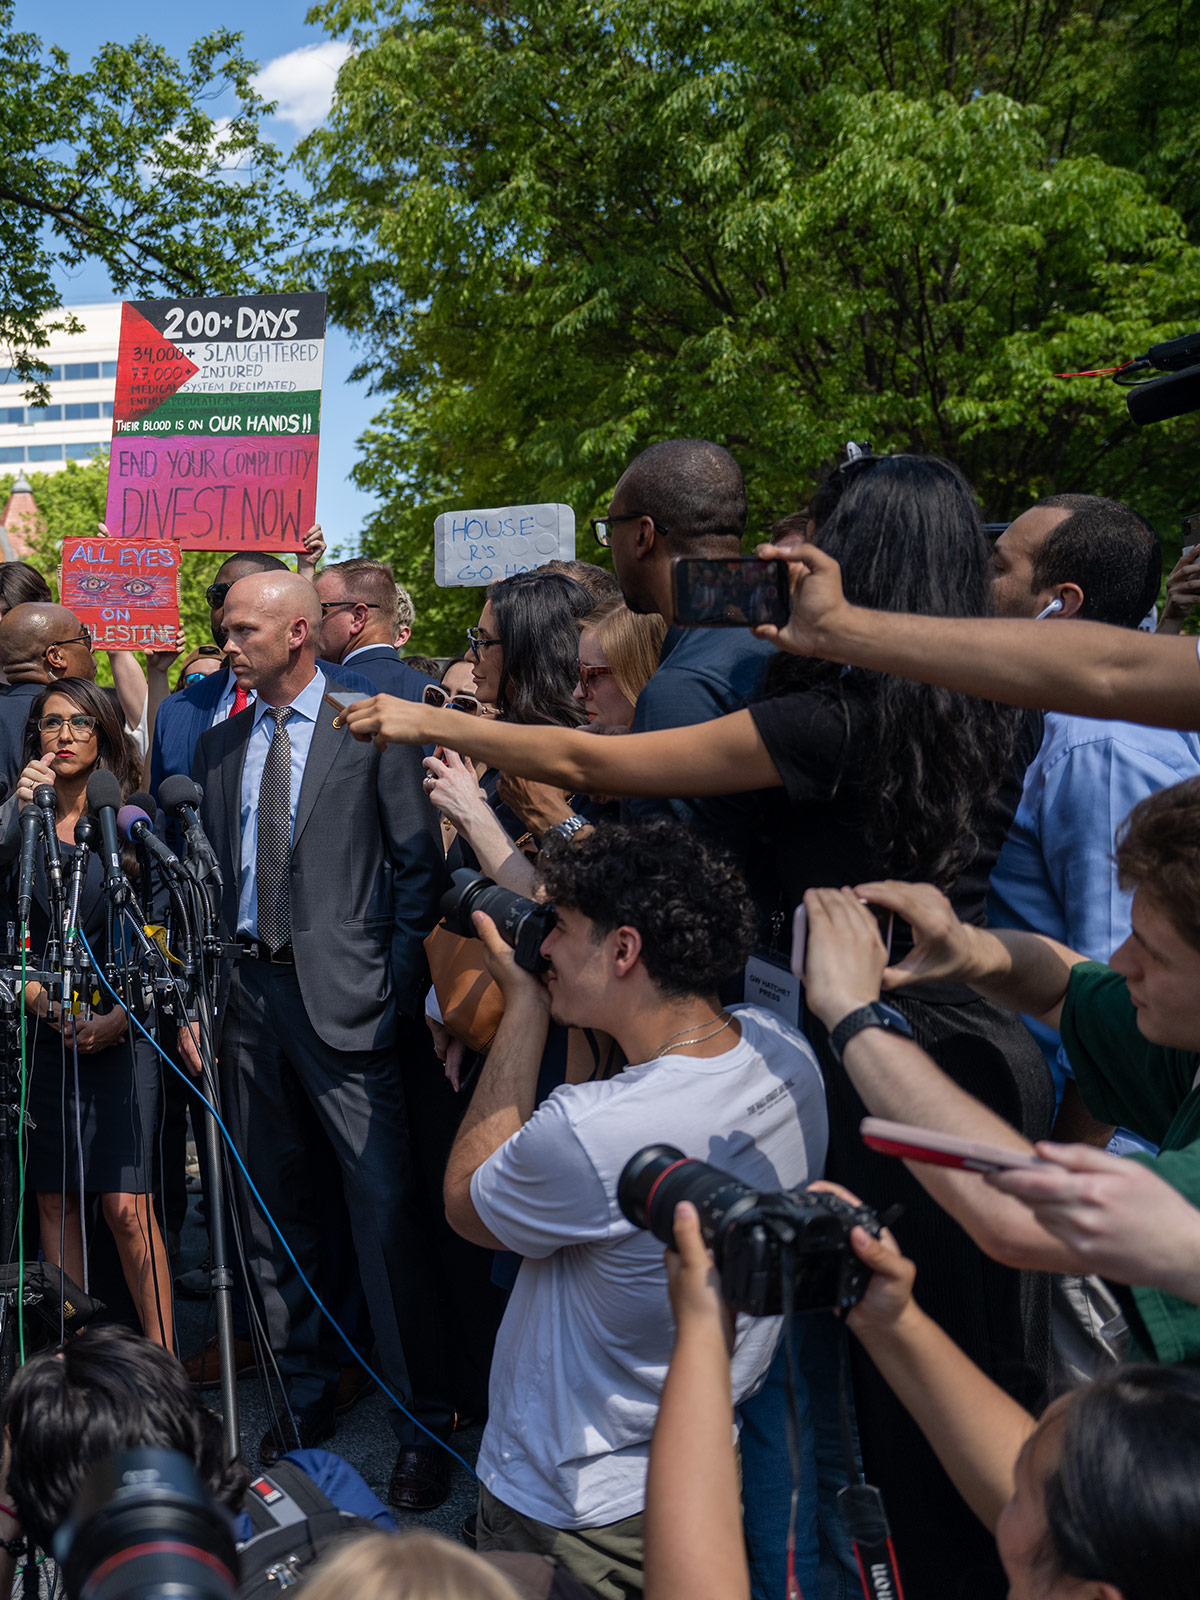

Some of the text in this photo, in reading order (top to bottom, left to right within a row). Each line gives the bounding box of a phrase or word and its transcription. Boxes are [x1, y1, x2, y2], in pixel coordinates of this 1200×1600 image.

[162, 307, 300, 339] 200+ DAYS
[132, 342, 319, 364] 34,000+ SLAUGHTERED
[200, 364, 263, 379] INJURED
[130, 380, 297, 394] MEDICAL SYSTEM DECIMATED
[171, 395, 233, 407] POPULATION
[115, 413, 312, 434] THEIR BLOOD IS ON OUR HANDS!!
[119, 448, 314, 480] END YOUR COMPLICITY
[240, 486, 302, 543] NOW
[452, 516, 534, 542] HOUSE
[69, 545, 175, 567] ALL EYES
[457, 565, 494, 580] GO
[100, 607, 131, 622] ON
[87, 622, 176, 644] LESTINE
[759, 988, 780, 1002] PRESS
[761, 980, 791, 998] HATCHET
